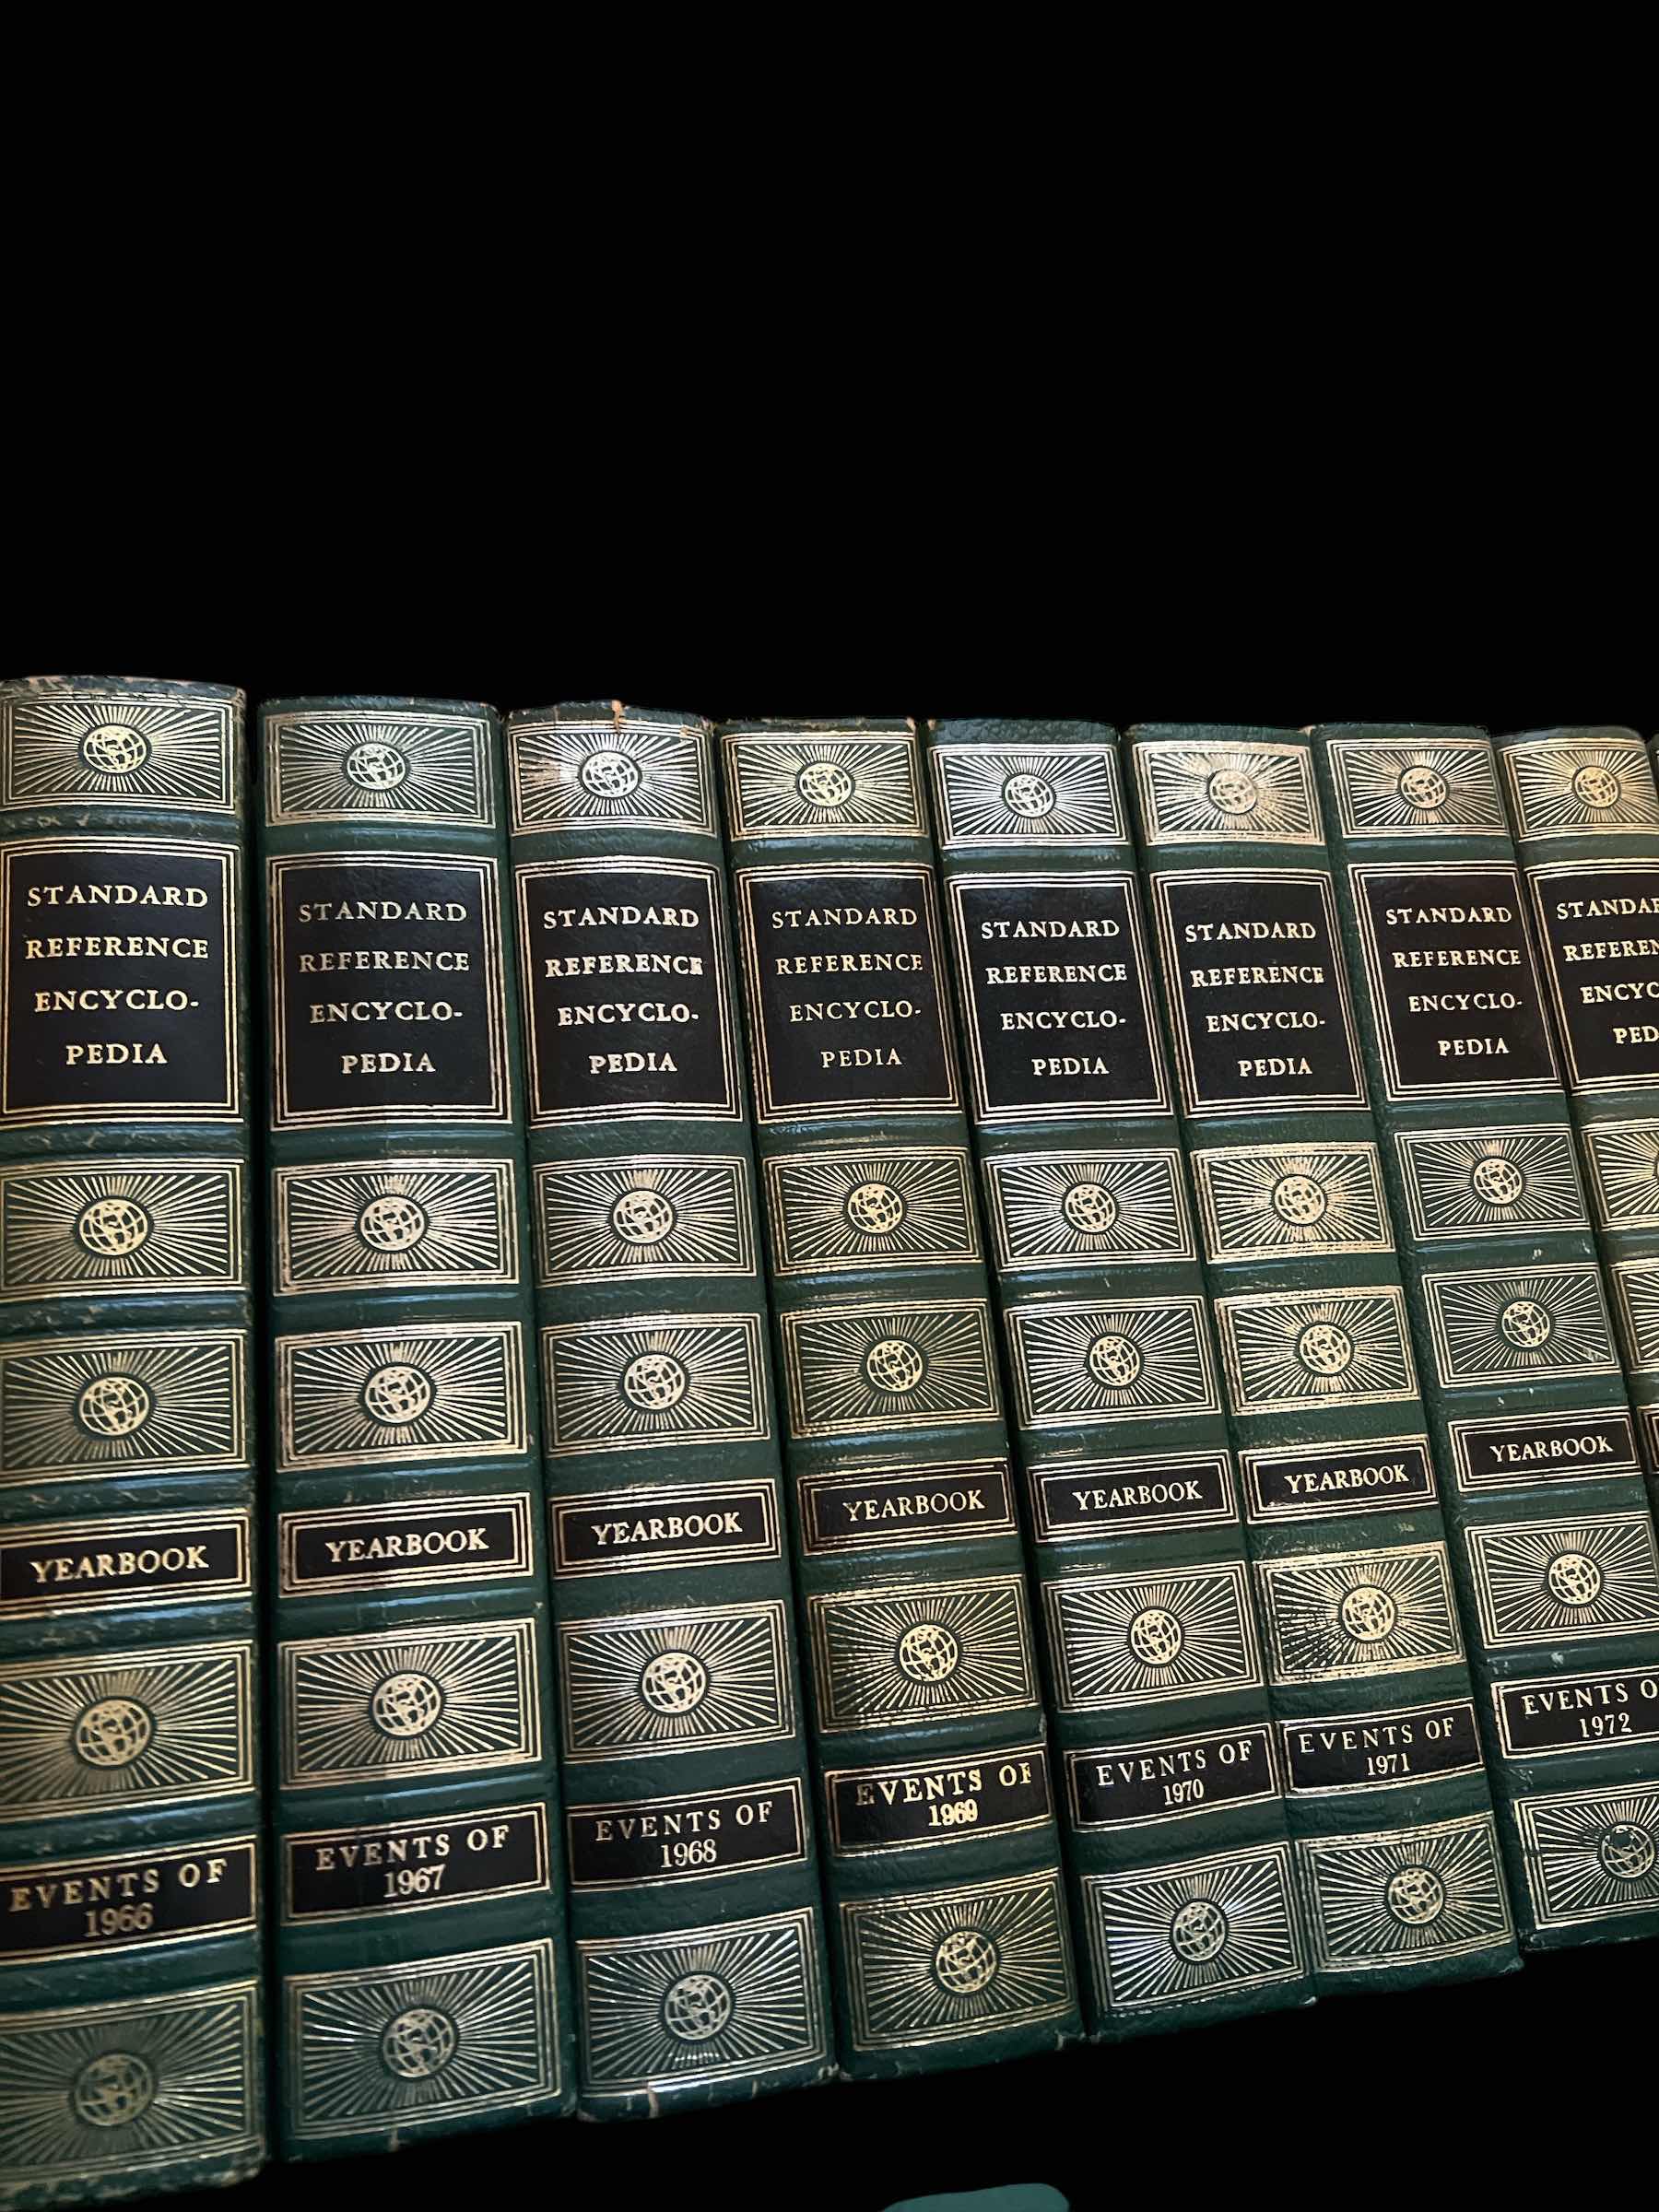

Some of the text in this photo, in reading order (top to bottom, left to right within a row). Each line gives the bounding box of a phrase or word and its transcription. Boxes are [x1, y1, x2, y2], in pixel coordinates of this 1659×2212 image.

[28, 885, 207, 907] STANDARD
[300, 901, 466, 922] STANDARD
[545, 906, 699, 929] STANDARD
[772, 908, 917, 928] STANDARD
[1386, 907, 1512, 924] STANDARD
[982, 920, 1119, 939] STANDARD
[1185, 922, 1315, 942] STANDARD
[26, 936, 207, 959] REFERENCE
[1393, 949, 1521, 968] REFERENCE
[300, 951, 469, 971] REFERENCE
[546, 954, 702, 977] REFERENCE
[776, 954, 921, 974] REFERENCE
[985, 964, 1127, 984] REFERENCE
[1190, 967, 1324, 987] REFERENCE
[35, 990, 198, 1012] ENCYCLO-
[1408, 993, 1522, 1011] ENCYCLO-
[1581, 982, 1659, 1003] ENCYC
[311, 1002, 463, 1023] ENCYCLO-
[558, 1003, 699, 1026] ENCYCLO-
[790, 1001, 921, 1021] ENCYCLO-
[1001, 1010, 1125, 1030] ENCYCLO-
[1206, 1012, 1324, 1032] ENCYCLO-
[1613, 1026, 1659, 1043] PED
[66, 1043, 167, 1065] PEDIA
[821, 1048, 901, 1067] PEDIA
[1438, 1038, 1509, 1055] PEDIA
[342, 1053, 435, 1074] PEDIA
[589, 1053, 677, 1074] PEDIA
[1031, 1057, 1109, 1076] PEDIA
[1238, 1058, 1312, 1077] PEDIA
[1489, 1436, 1613, 1462] YEARBOOK
[1284, 1465, 1409, 1493] YEARBOOK
[843, 1489, 984, 1521] YEARBOOK
[1072, 1480, 1202, 1510] YEARBOOK
[592, 1512, 742, 1545] YEARBOOK
[325, 1528, 489, 1562] YEARBOOK
[30, 1546, 208, 1583] YEARBOOK
[1522, 1683, 1628, 1714] EVENTS
[1299, 1717, 1453, 1753] EVENTS OF
[1580, 1712, 1632, 1737] 1972
[1098, 1740, 1252, 1787] EVENTS OF
[1368, 1753, 1409, 1775] 1971
[856, 1762, 1030, 1806] EVENTS OF
[1163, 1779, 1204, 1806] 1970
[595, 1801, 771, 1841] EVENTS OF
[929, 1799, 978, 1826] 1969
[316, 1825, 509, 1871] EVENTS OF
[661, 1839, 716, 1867] 1968
[9, 1859, 227, 1912] EVENTS OF
[384, 1865, 445, 1897] 1967
[86, 1902, 153, 1936] 1966
